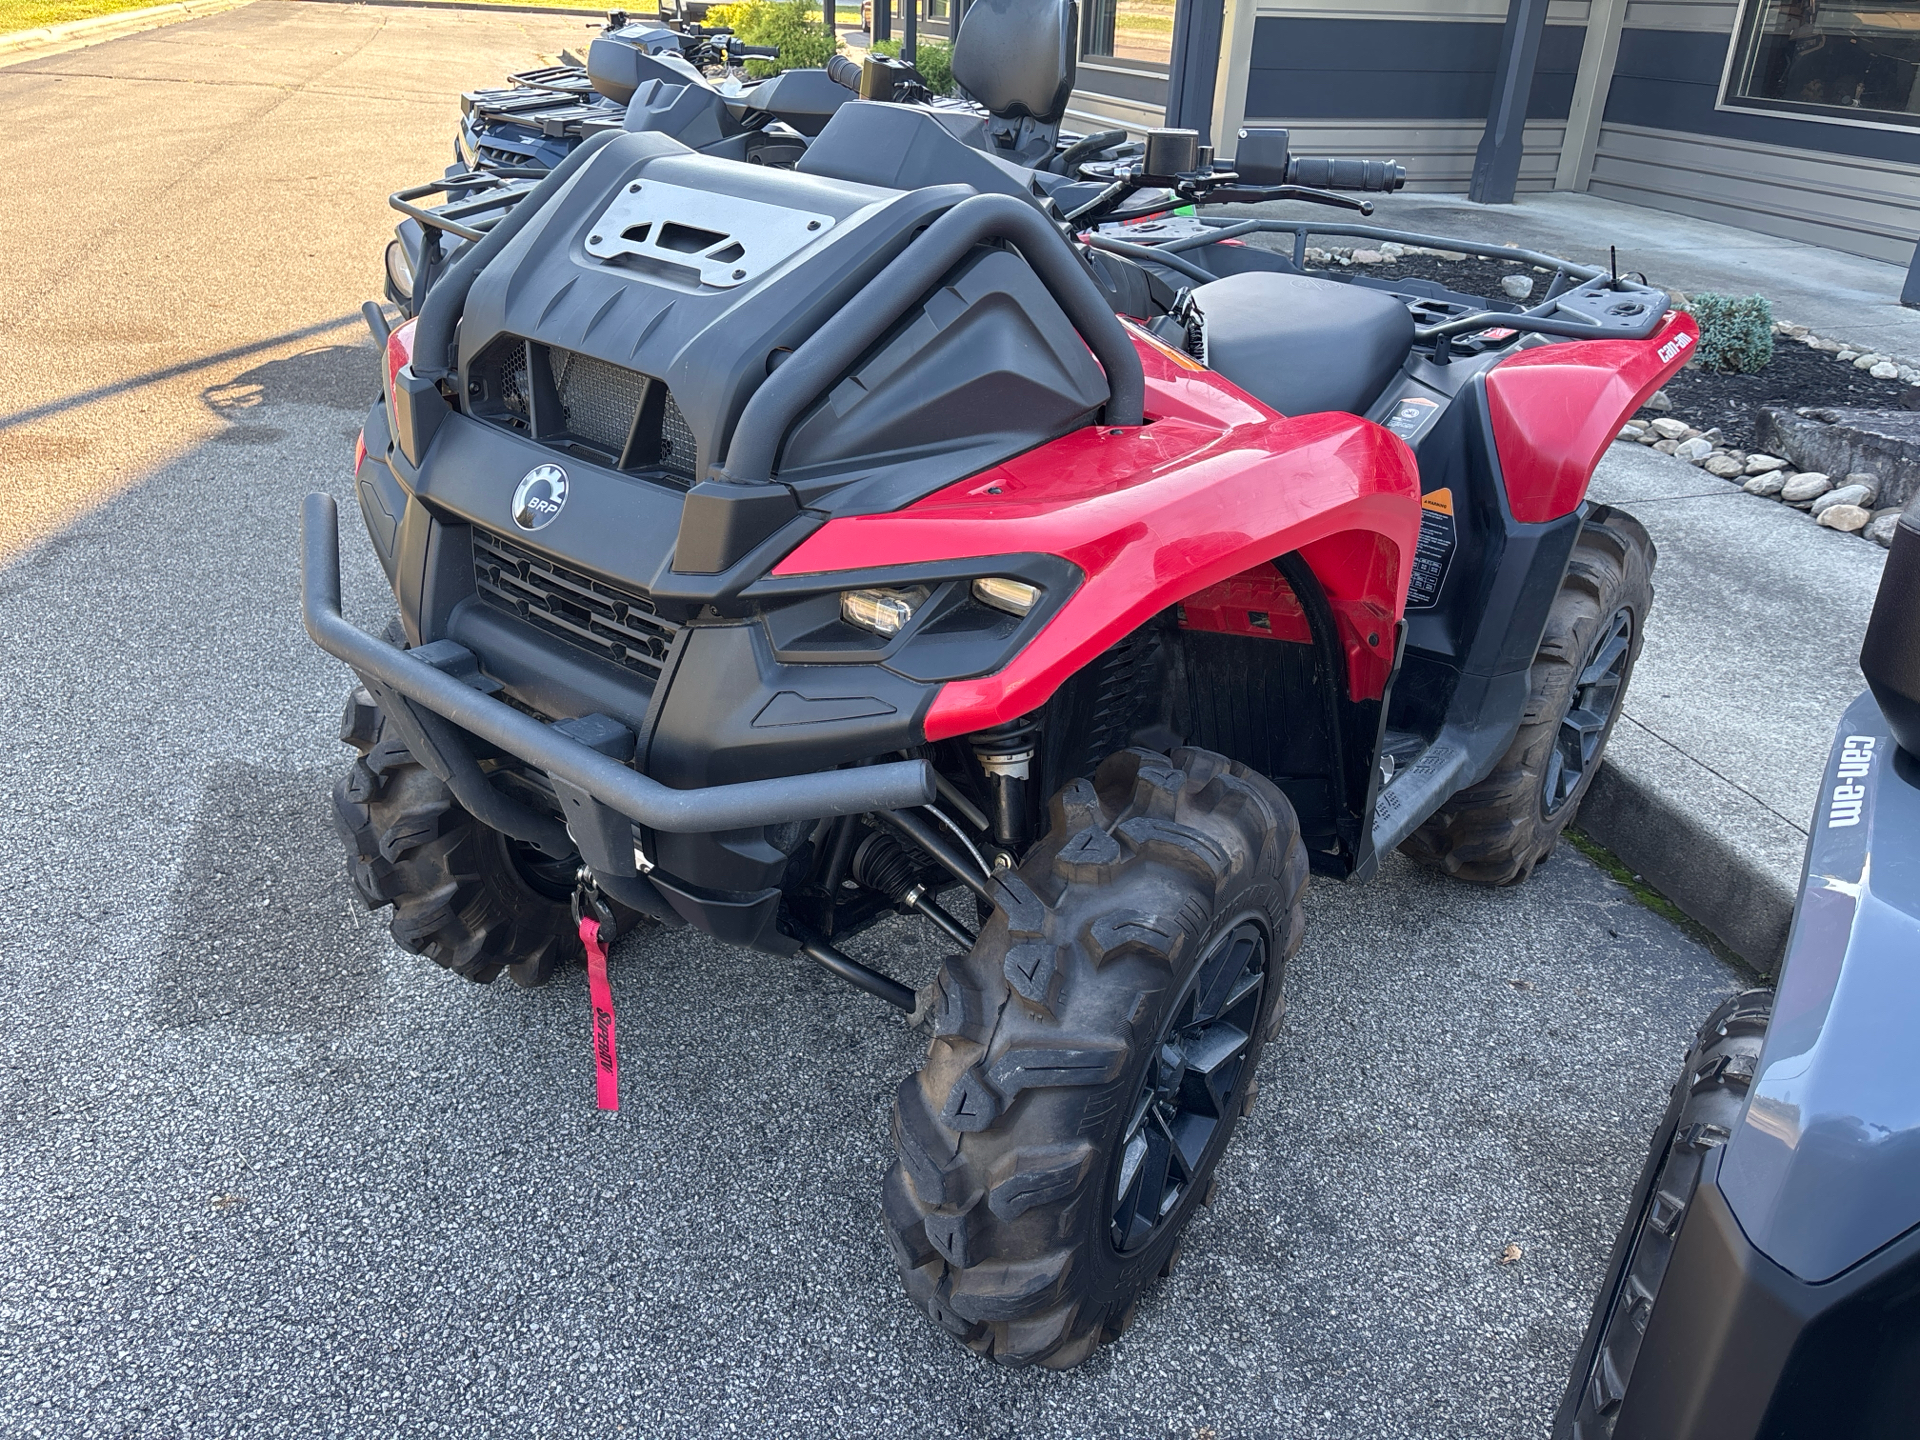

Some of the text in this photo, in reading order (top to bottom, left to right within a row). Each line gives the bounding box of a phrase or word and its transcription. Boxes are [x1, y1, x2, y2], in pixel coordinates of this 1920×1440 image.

[1657, 331, 1693, 364] can-am
[527, 496, 558, 514] BRP
[1828, 735, 1876, 829] can-am
